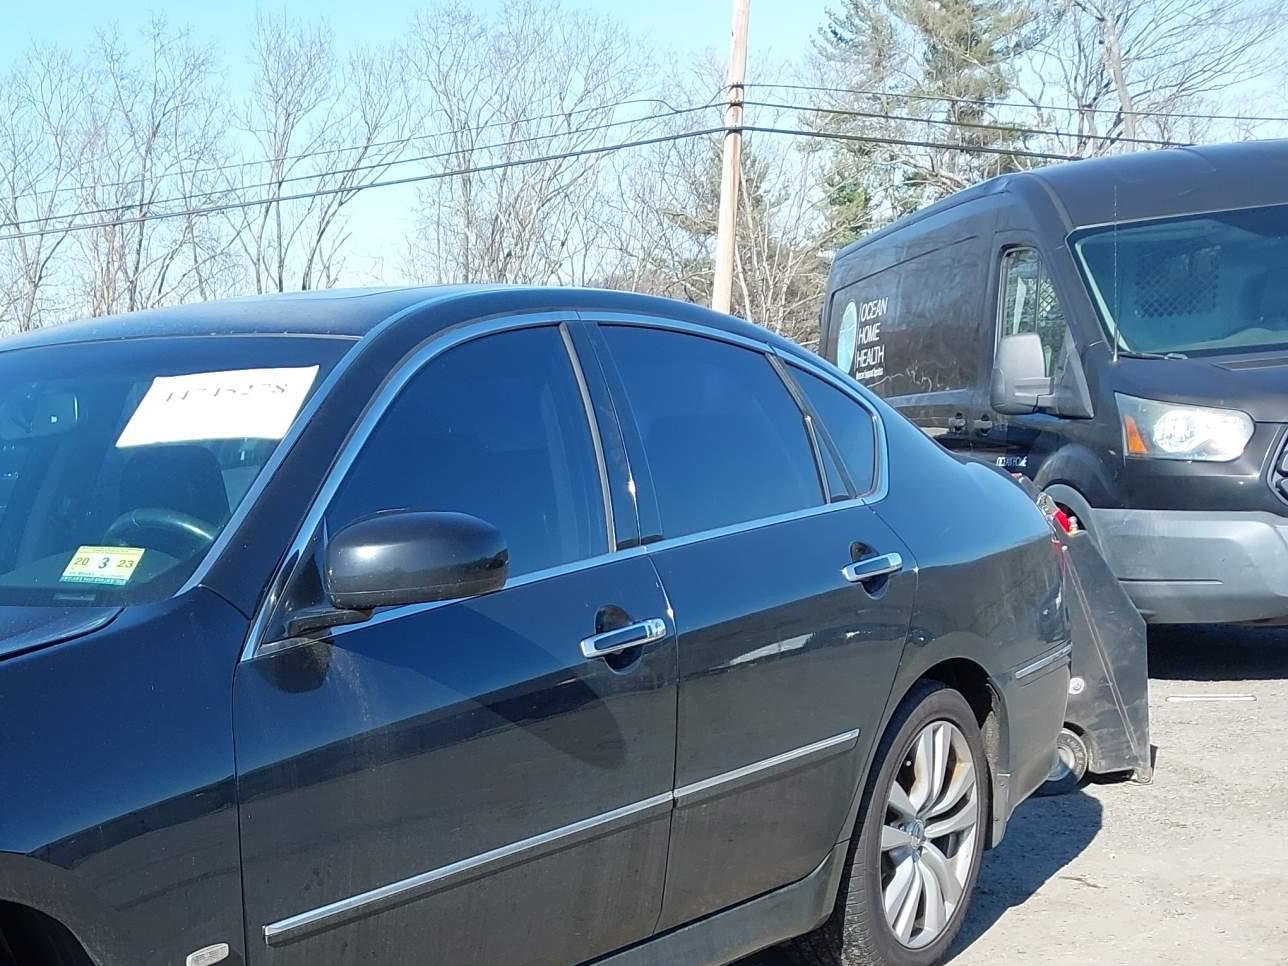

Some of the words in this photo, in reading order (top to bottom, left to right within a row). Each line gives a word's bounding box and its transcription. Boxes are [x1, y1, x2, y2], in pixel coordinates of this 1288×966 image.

[861, 297, 889, 322] OCEAN
[858, 323, 881, 345] HOME
[856, 344, 885, 368] HEALTH
[73, 557, 90, 566] 20
[98, 557, 110, 569] 3
[117, 559, 135, 569] 23
